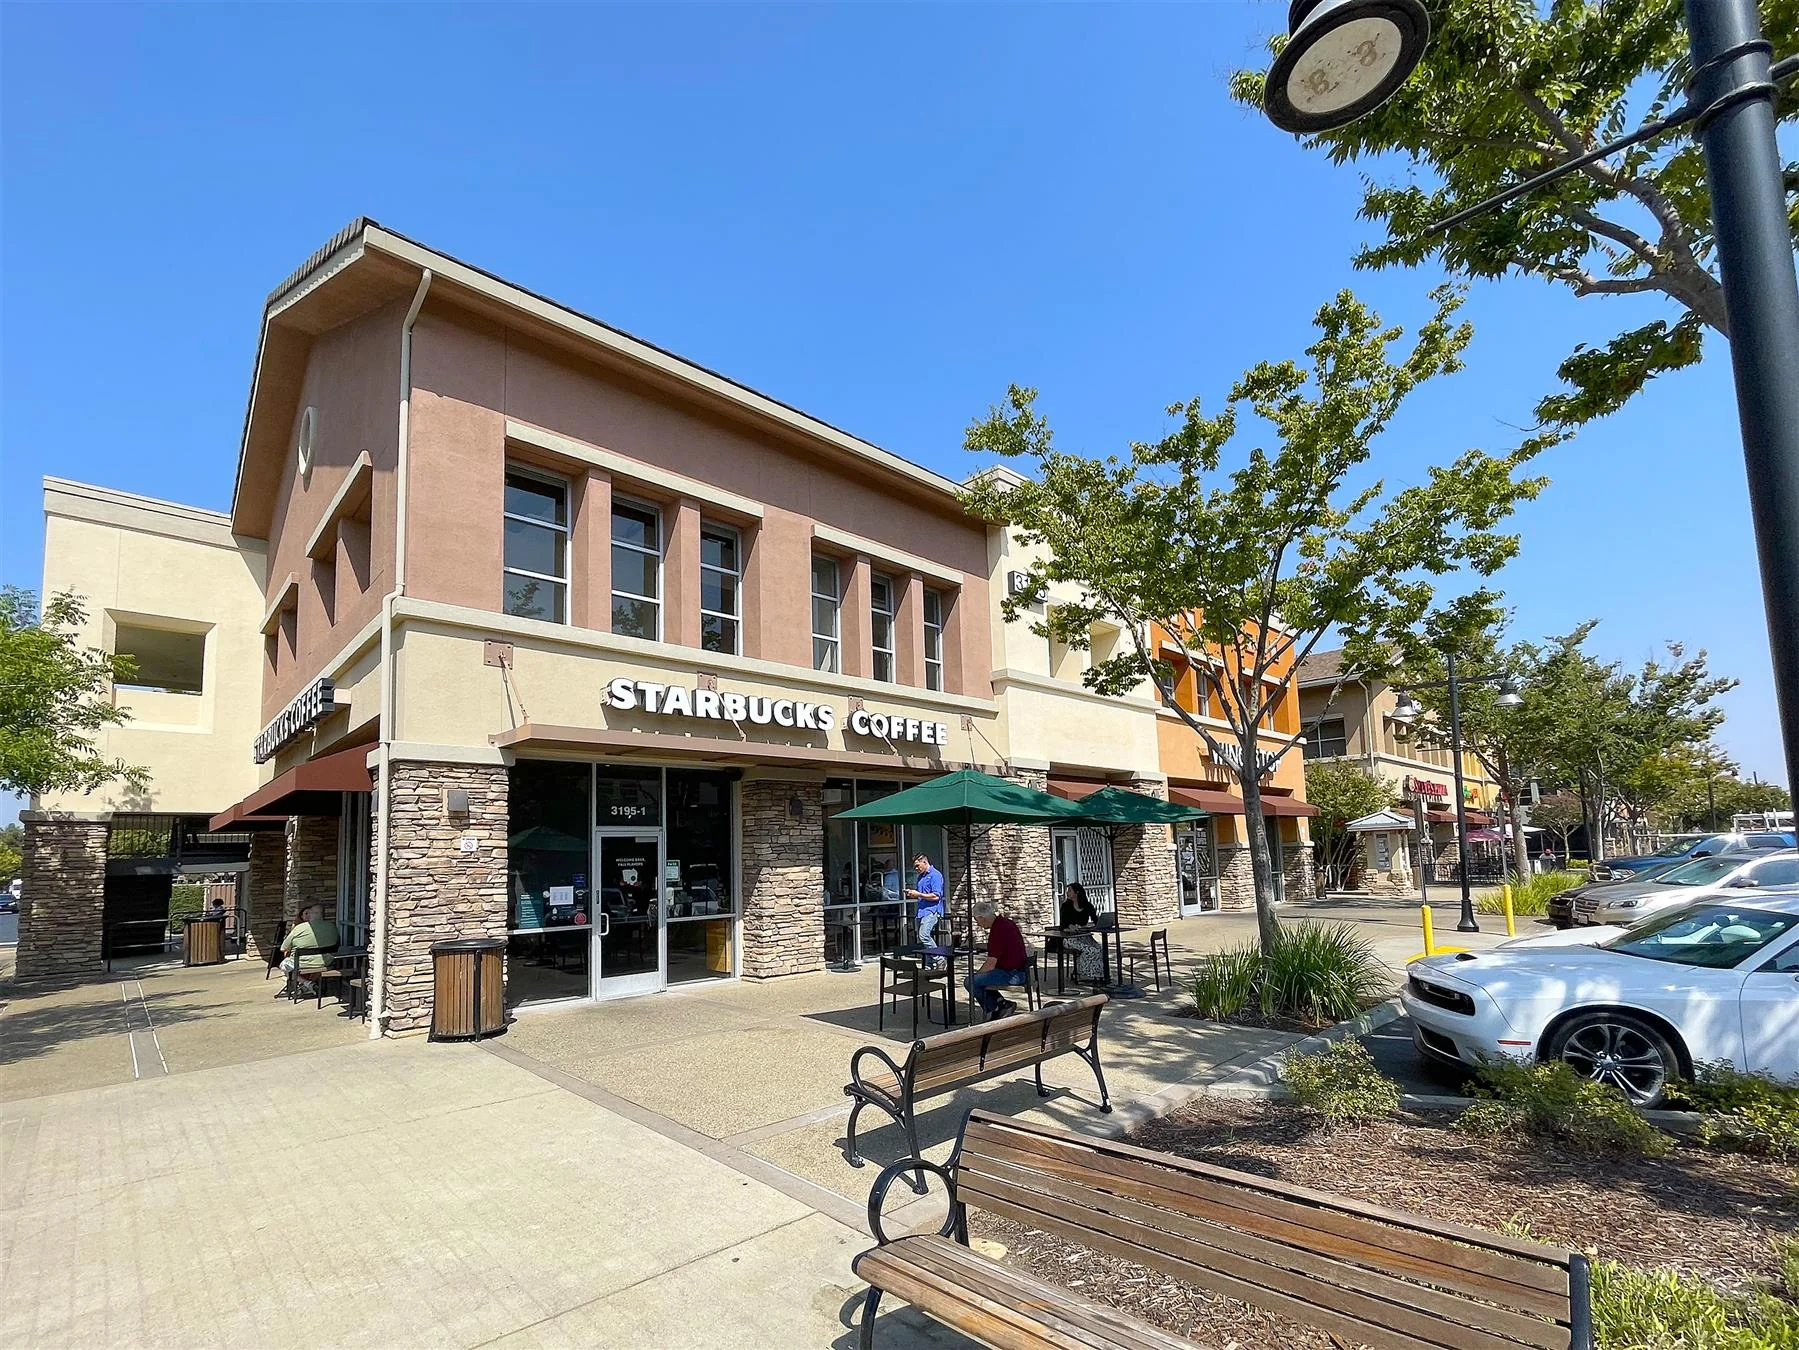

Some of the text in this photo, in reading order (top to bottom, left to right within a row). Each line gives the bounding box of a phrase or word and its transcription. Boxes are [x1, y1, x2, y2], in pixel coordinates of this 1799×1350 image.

[290, 679, 325, 734] COFFEE
[610, 677, 949, 745] STARBUCKS COFFEE
[611, 805, 646, 816] 3195-1
